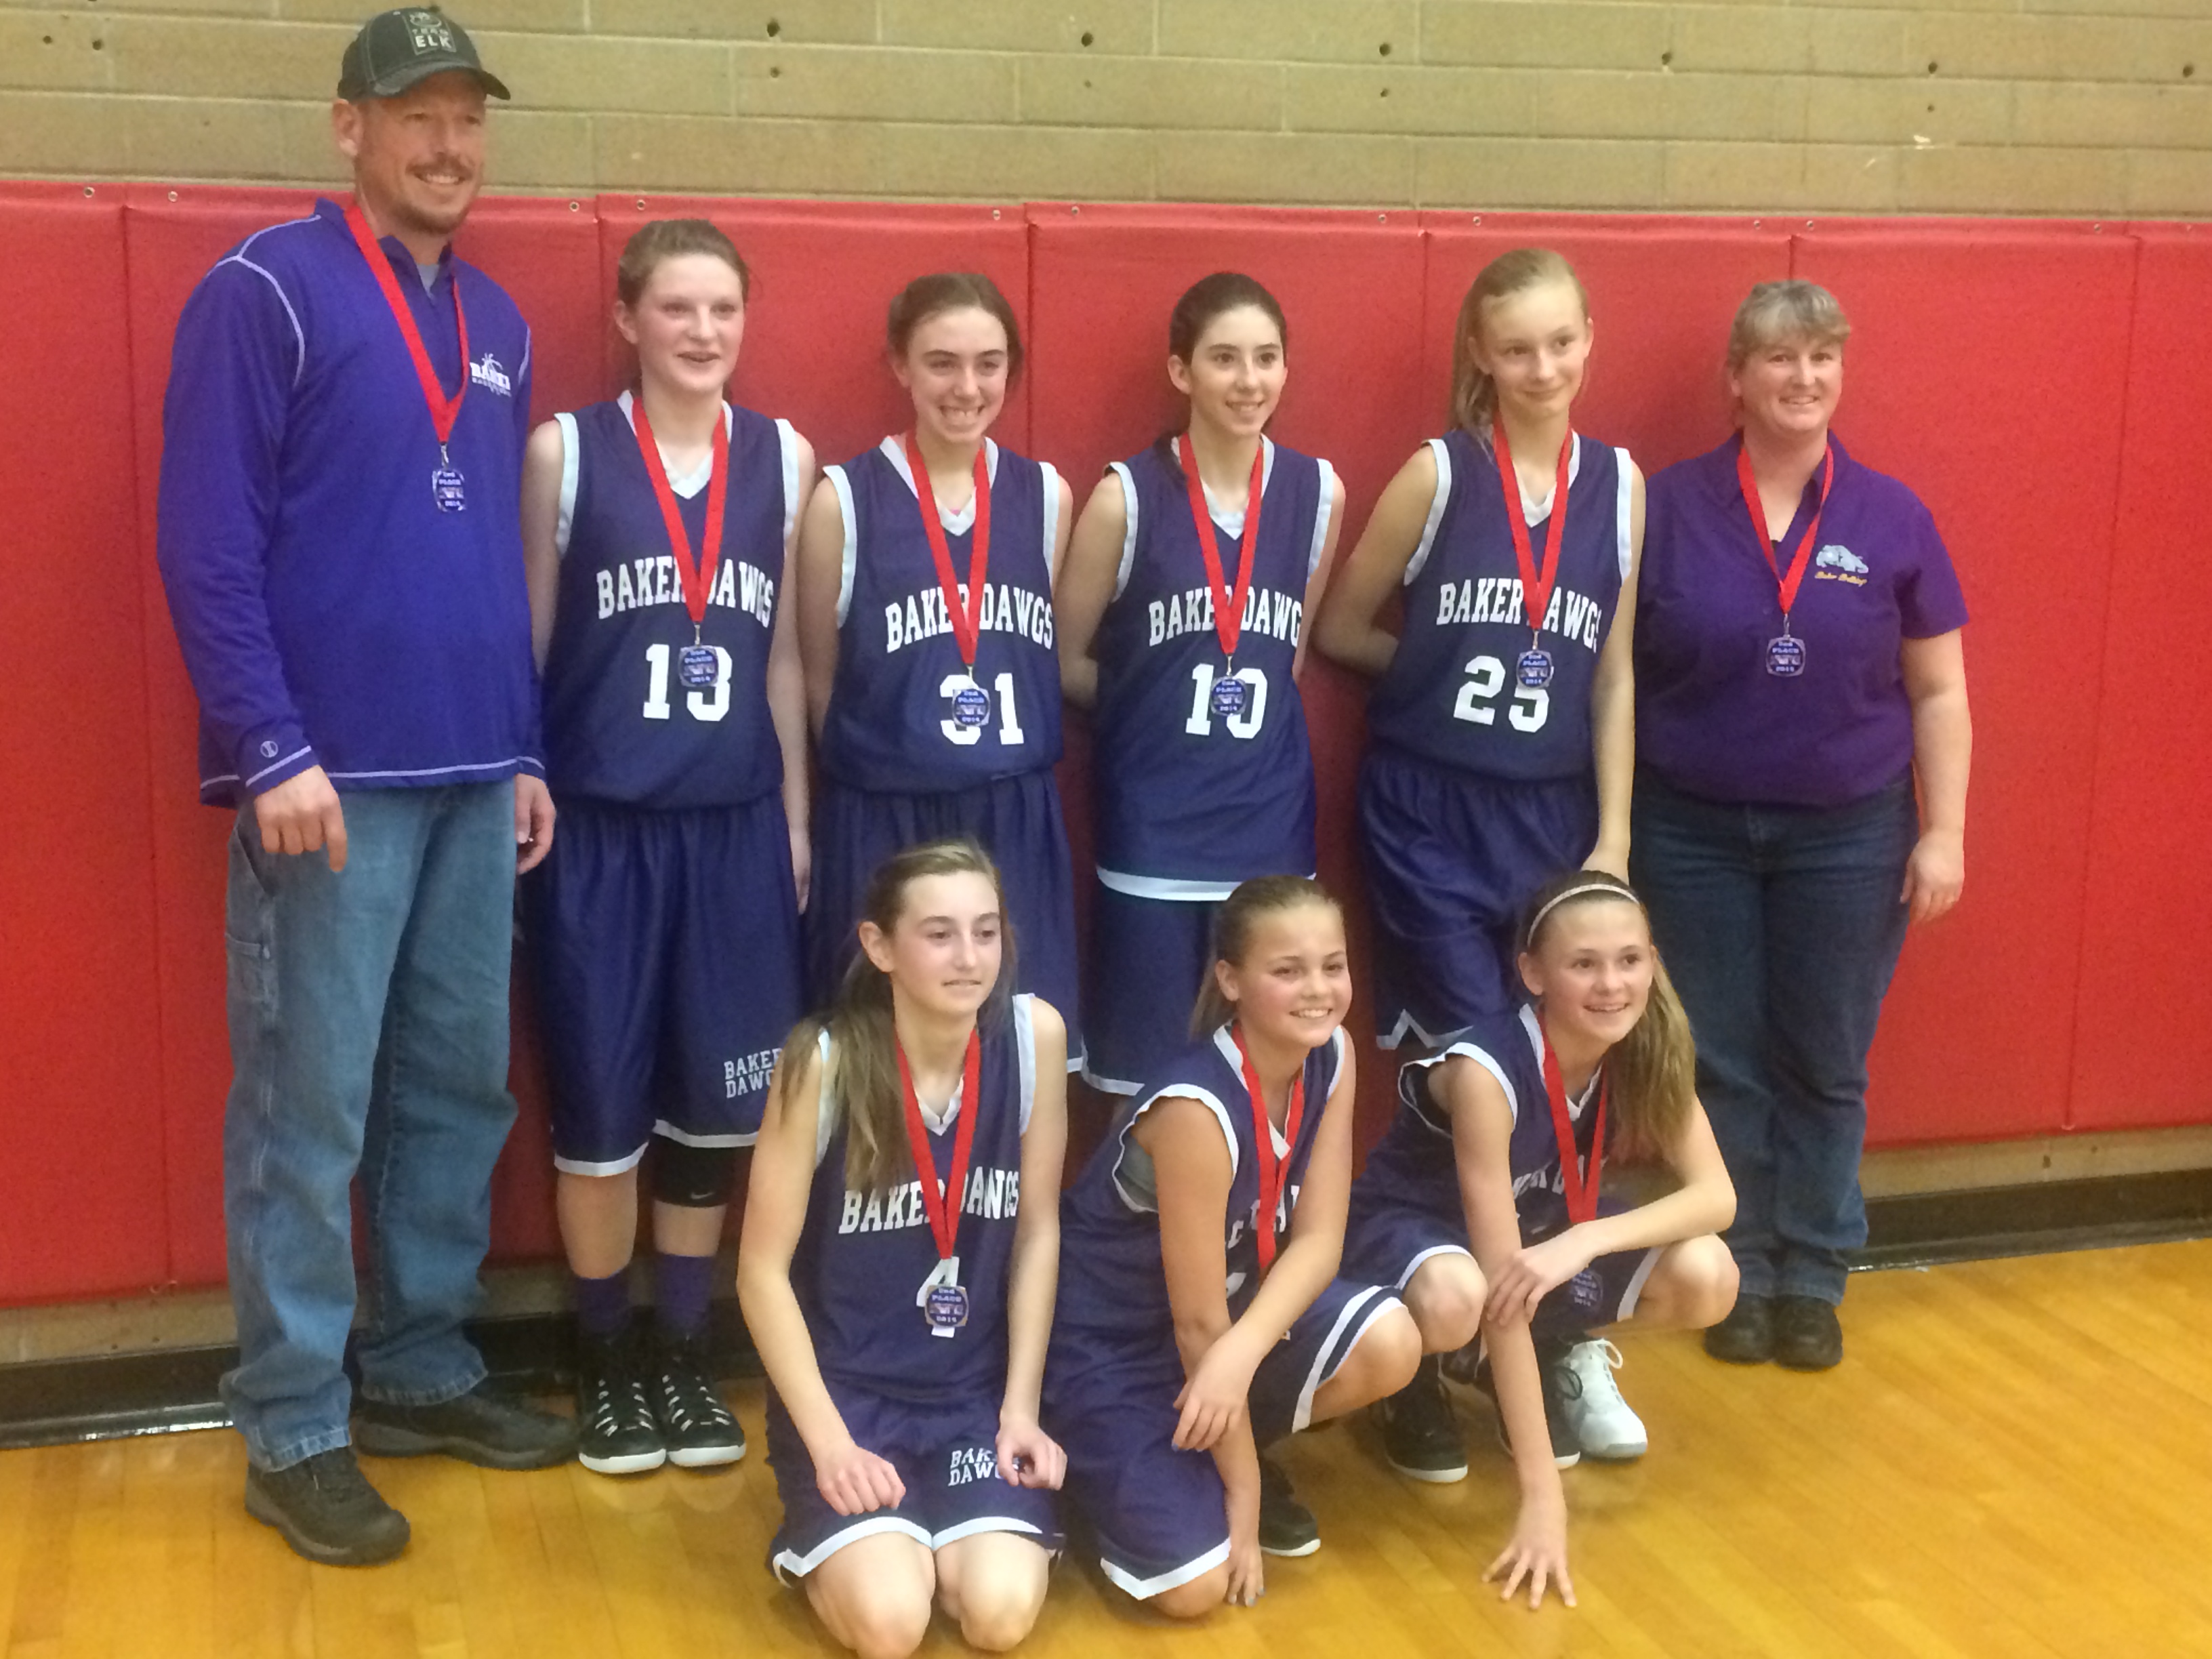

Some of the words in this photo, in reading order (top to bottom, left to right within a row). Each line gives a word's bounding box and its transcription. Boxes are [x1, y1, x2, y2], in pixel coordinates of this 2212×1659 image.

[415, 35, 452, 49] ELK
[706, 558, 774, 628] AWGS
[979, 583, 1053, 650] DAWGS
[1149, 585, 1233, 647] BAKE
[1240, 586, 1303, 649] DAWG
[1436, 577, 1524, 626] BAKER
[1526, 586, 1602, 653] AWG
[643, 643, 733, 722] 13
[939, 672, 1025, 745] 31
[1185, 663, 1268, 739] 10
[1453, 655, 1550, 733] 25
[725, 1069, 775, 1099] DAW
[947, 1461, 1004, 1487] DAW
[950, 1448, 999, 1469] BAK
